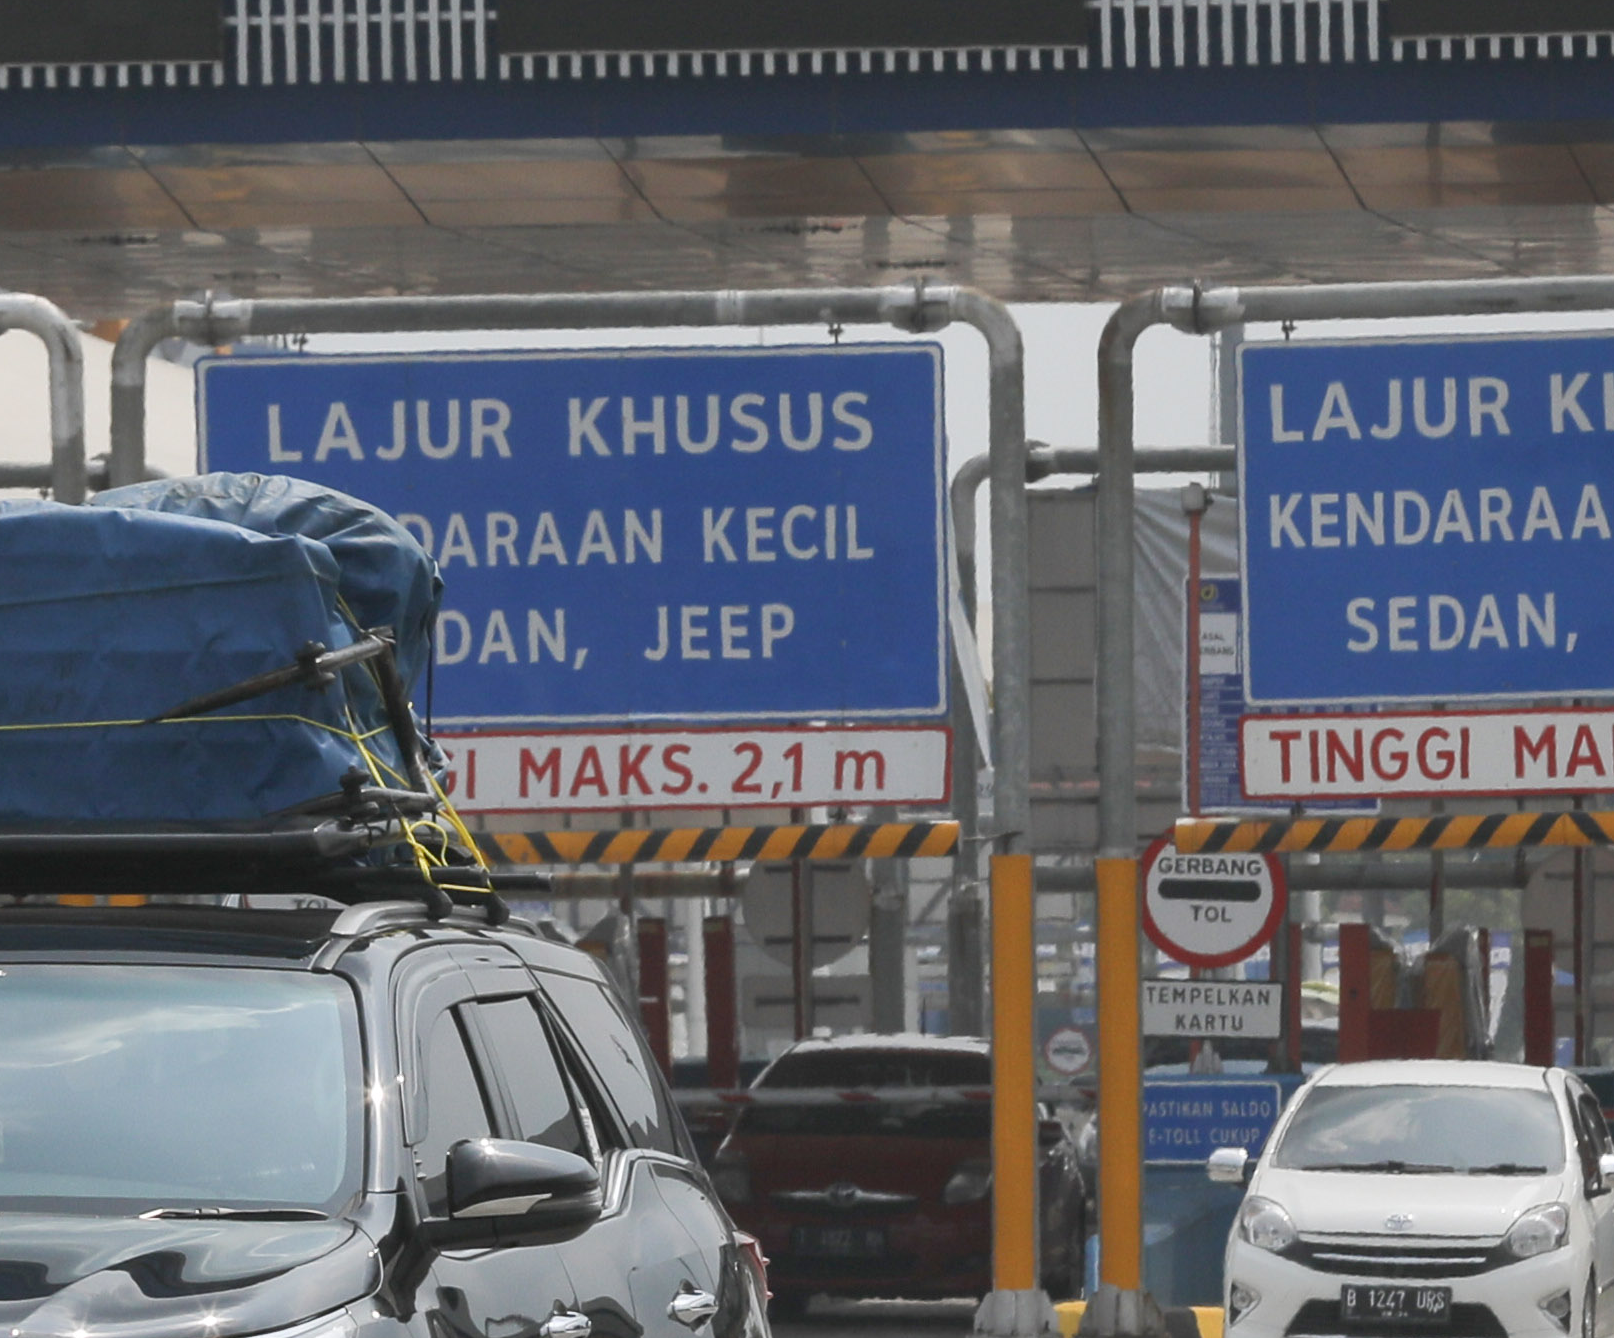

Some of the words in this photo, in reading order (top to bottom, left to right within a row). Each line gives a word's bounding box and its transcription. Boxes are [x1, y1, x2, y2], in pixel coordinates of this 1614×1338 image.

[268, 398, 512, 464] LAJUR
[569, 391, 873, 456] KHUSUS
[1269, 376, 1510, 444] LAJUR
[403, 508, 663, 567] DARAAN
[702, 505, 875, 563] KECIL
[435, 606, 589, 670] DAN,
[644, 603, 795, 661] JEEP
[1346, 592, 1579, 653] SEDAN,
[518, 743, 709, 799] MAKS.
[1269, 726, 1470, 784] TINGGI
[1158, 857, 1262, 876] GERBANG
[1190, 905, 1232, 923] TOL
[1147, 986, 1270, 1006] TEMPELKAN
[1175, 1014, 1244, 1032] KARTU
[1222, 1101, 1271, 1119] SALDO
[1149, 1129, 1201, 1144] E-TOLL
[1210, 1128, 1261, 1144] CUKUP
[1347, 1289, 1356, 1307] B
[1368, 1290, 1406, 1309] 1247
